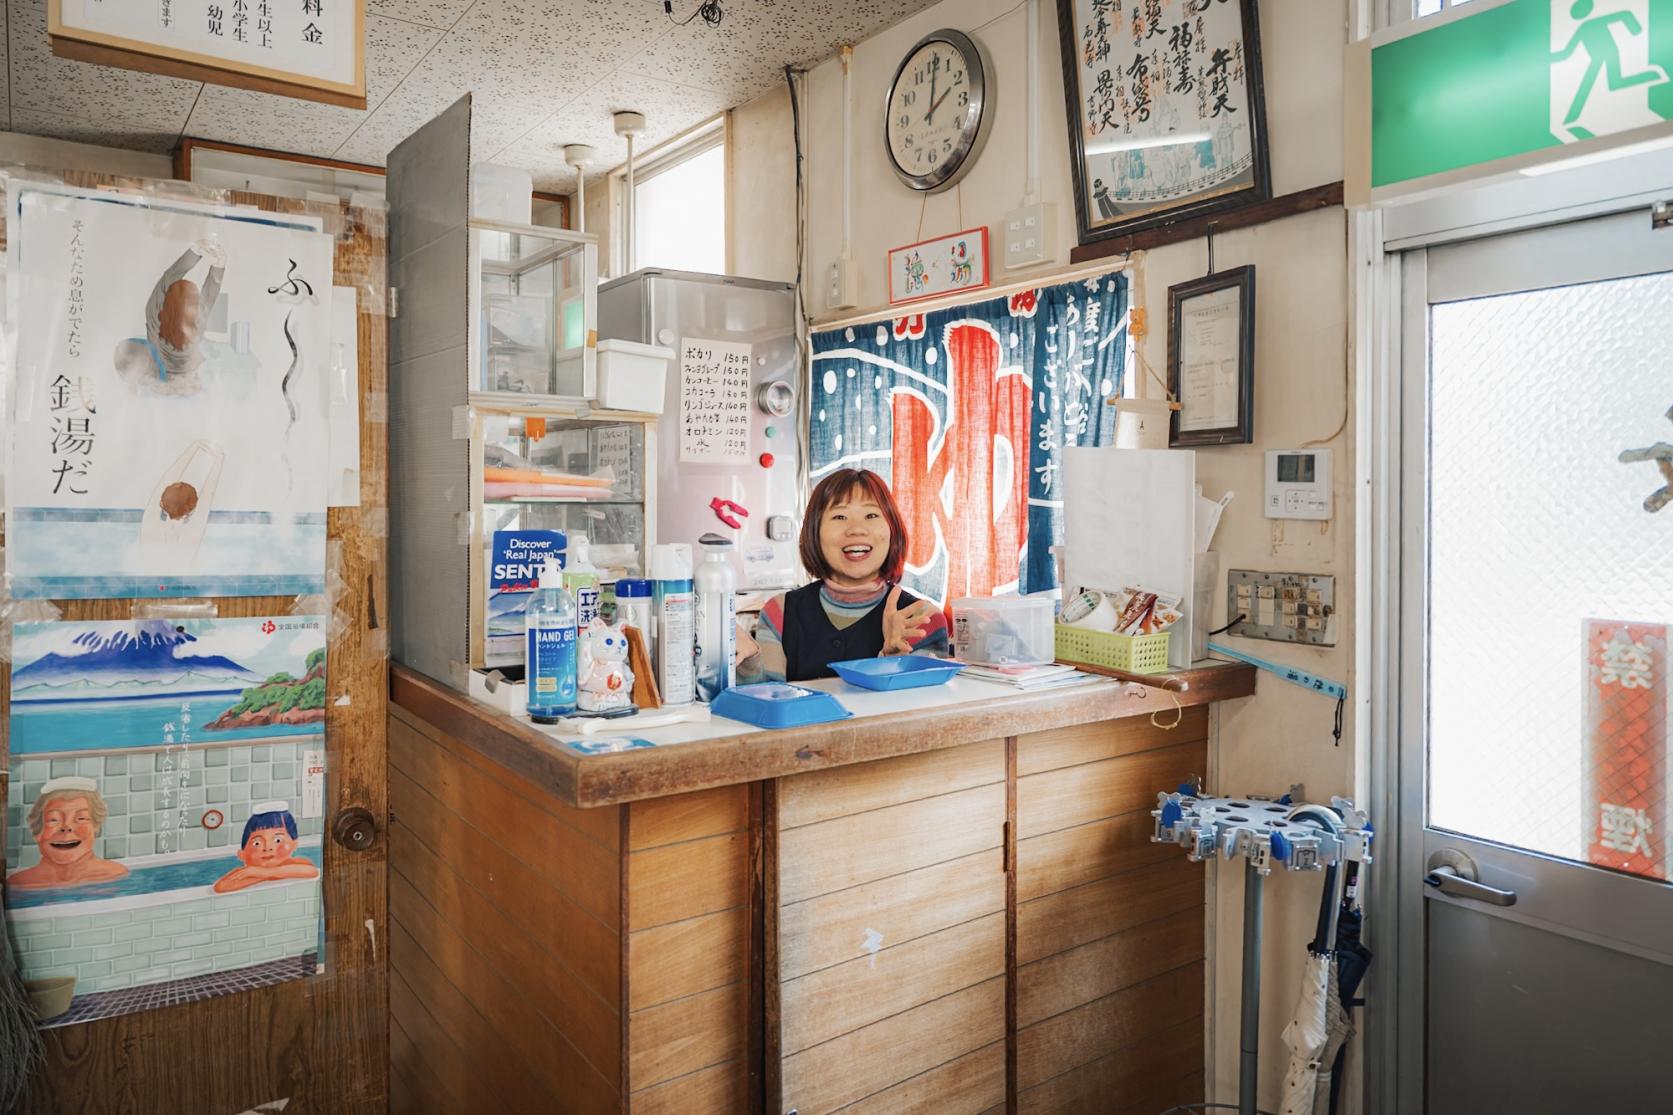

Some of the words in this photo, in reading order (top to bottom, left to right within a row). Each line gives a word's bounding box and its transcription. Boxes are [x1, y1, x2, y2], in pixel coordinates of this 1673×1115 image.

[207, 4, 224, 37] 幼児
[257, 0, 273, 49] 生以上
[945, 58, 951, 73] 1
[914, 70, 924, 86] 11
[953, 70, 963, 87] 2
[901, 90, 916, 107] 10
[958, 91, 969, 107] 3
[900, 114, 910, 129] 9
[952, 116, 962, 131] 4
[904, 134, 914, 149] 8
[942, 138, 952, 153] 5
[915, 148, 923, 163] 7
[927, 149, 938, 164] 6
[68, 219, 85, 359] そんなため息がでたら
[685, 347, 712, 360] ポカリ
[724, 353, 749, 364] 150円
[723, 367, 748, 378] 150円
[1034, 323, 1060, 496] ございます
[50, 374, 97, 495] 銭湯だ
[510, 538, 552, 549] Discover
[494, 563, 545, 580] SENT
